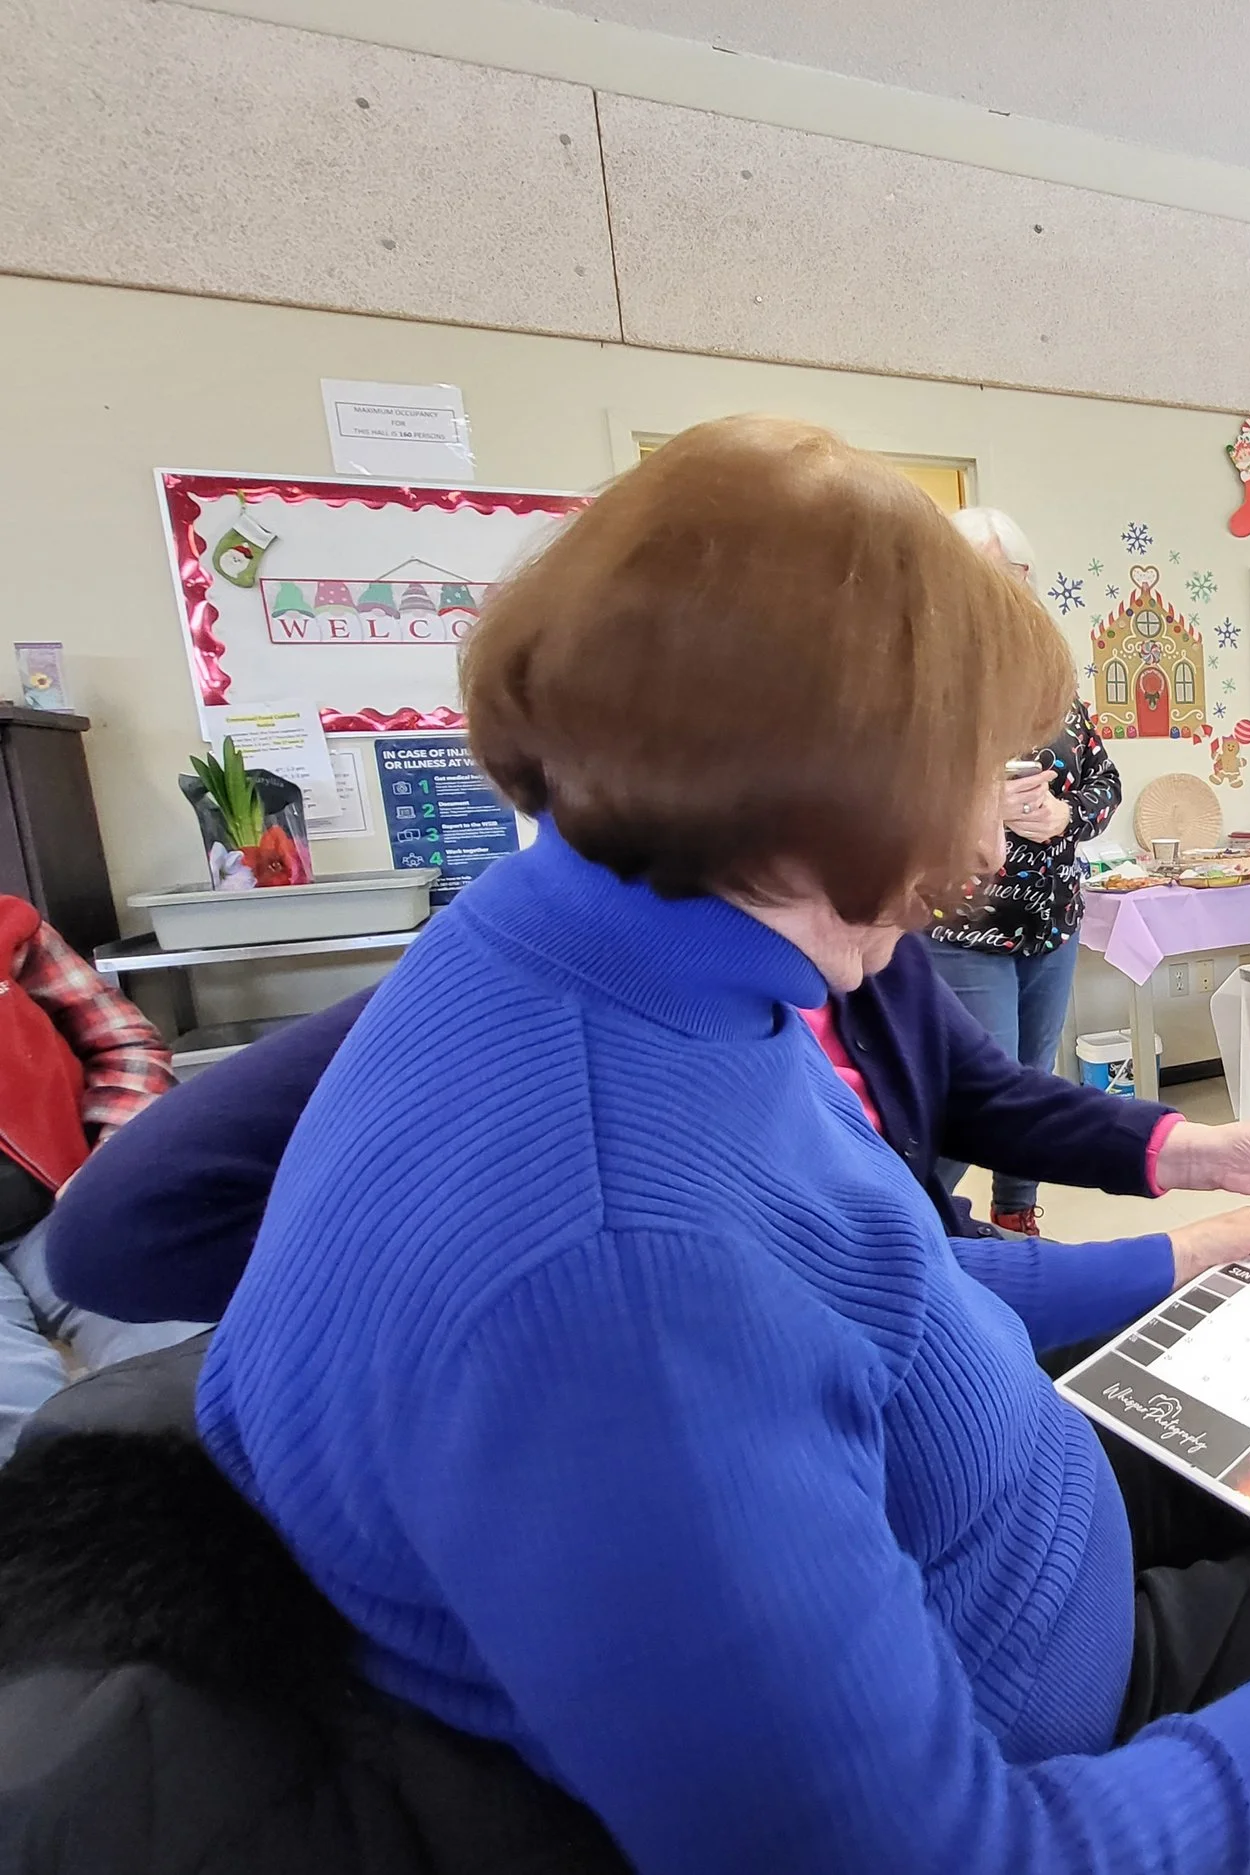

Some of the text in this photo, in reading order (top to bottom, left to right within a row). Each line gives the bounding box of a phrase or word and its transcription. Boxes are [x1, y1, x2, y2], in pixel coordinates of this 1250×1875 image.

[354, 406, 438, 418] MAXIMUM OCCUPANCY
[391, 419, 406, 427] FOR
[354, 427, 370, 436] THIS
[371, 430, 389, 438] HALL
[413, 432, 446, 441] PERSONS
[279, 617, 473, 640] WELCO
[382, 747, 473, 760] IN CASE OF INJU
[384, 761, 403, 771] OR
[403, 759, 447, 769] ILLNESS
[448, 757, 463, 768] AT
[418, 780, 430, 794] 1
[422, 803, 437, 818] 2
[425, 827, 441, 842] 3
[429, 851, 444, 866] 4
[1102, 1382, 1208, 1454] Whisper Photography
